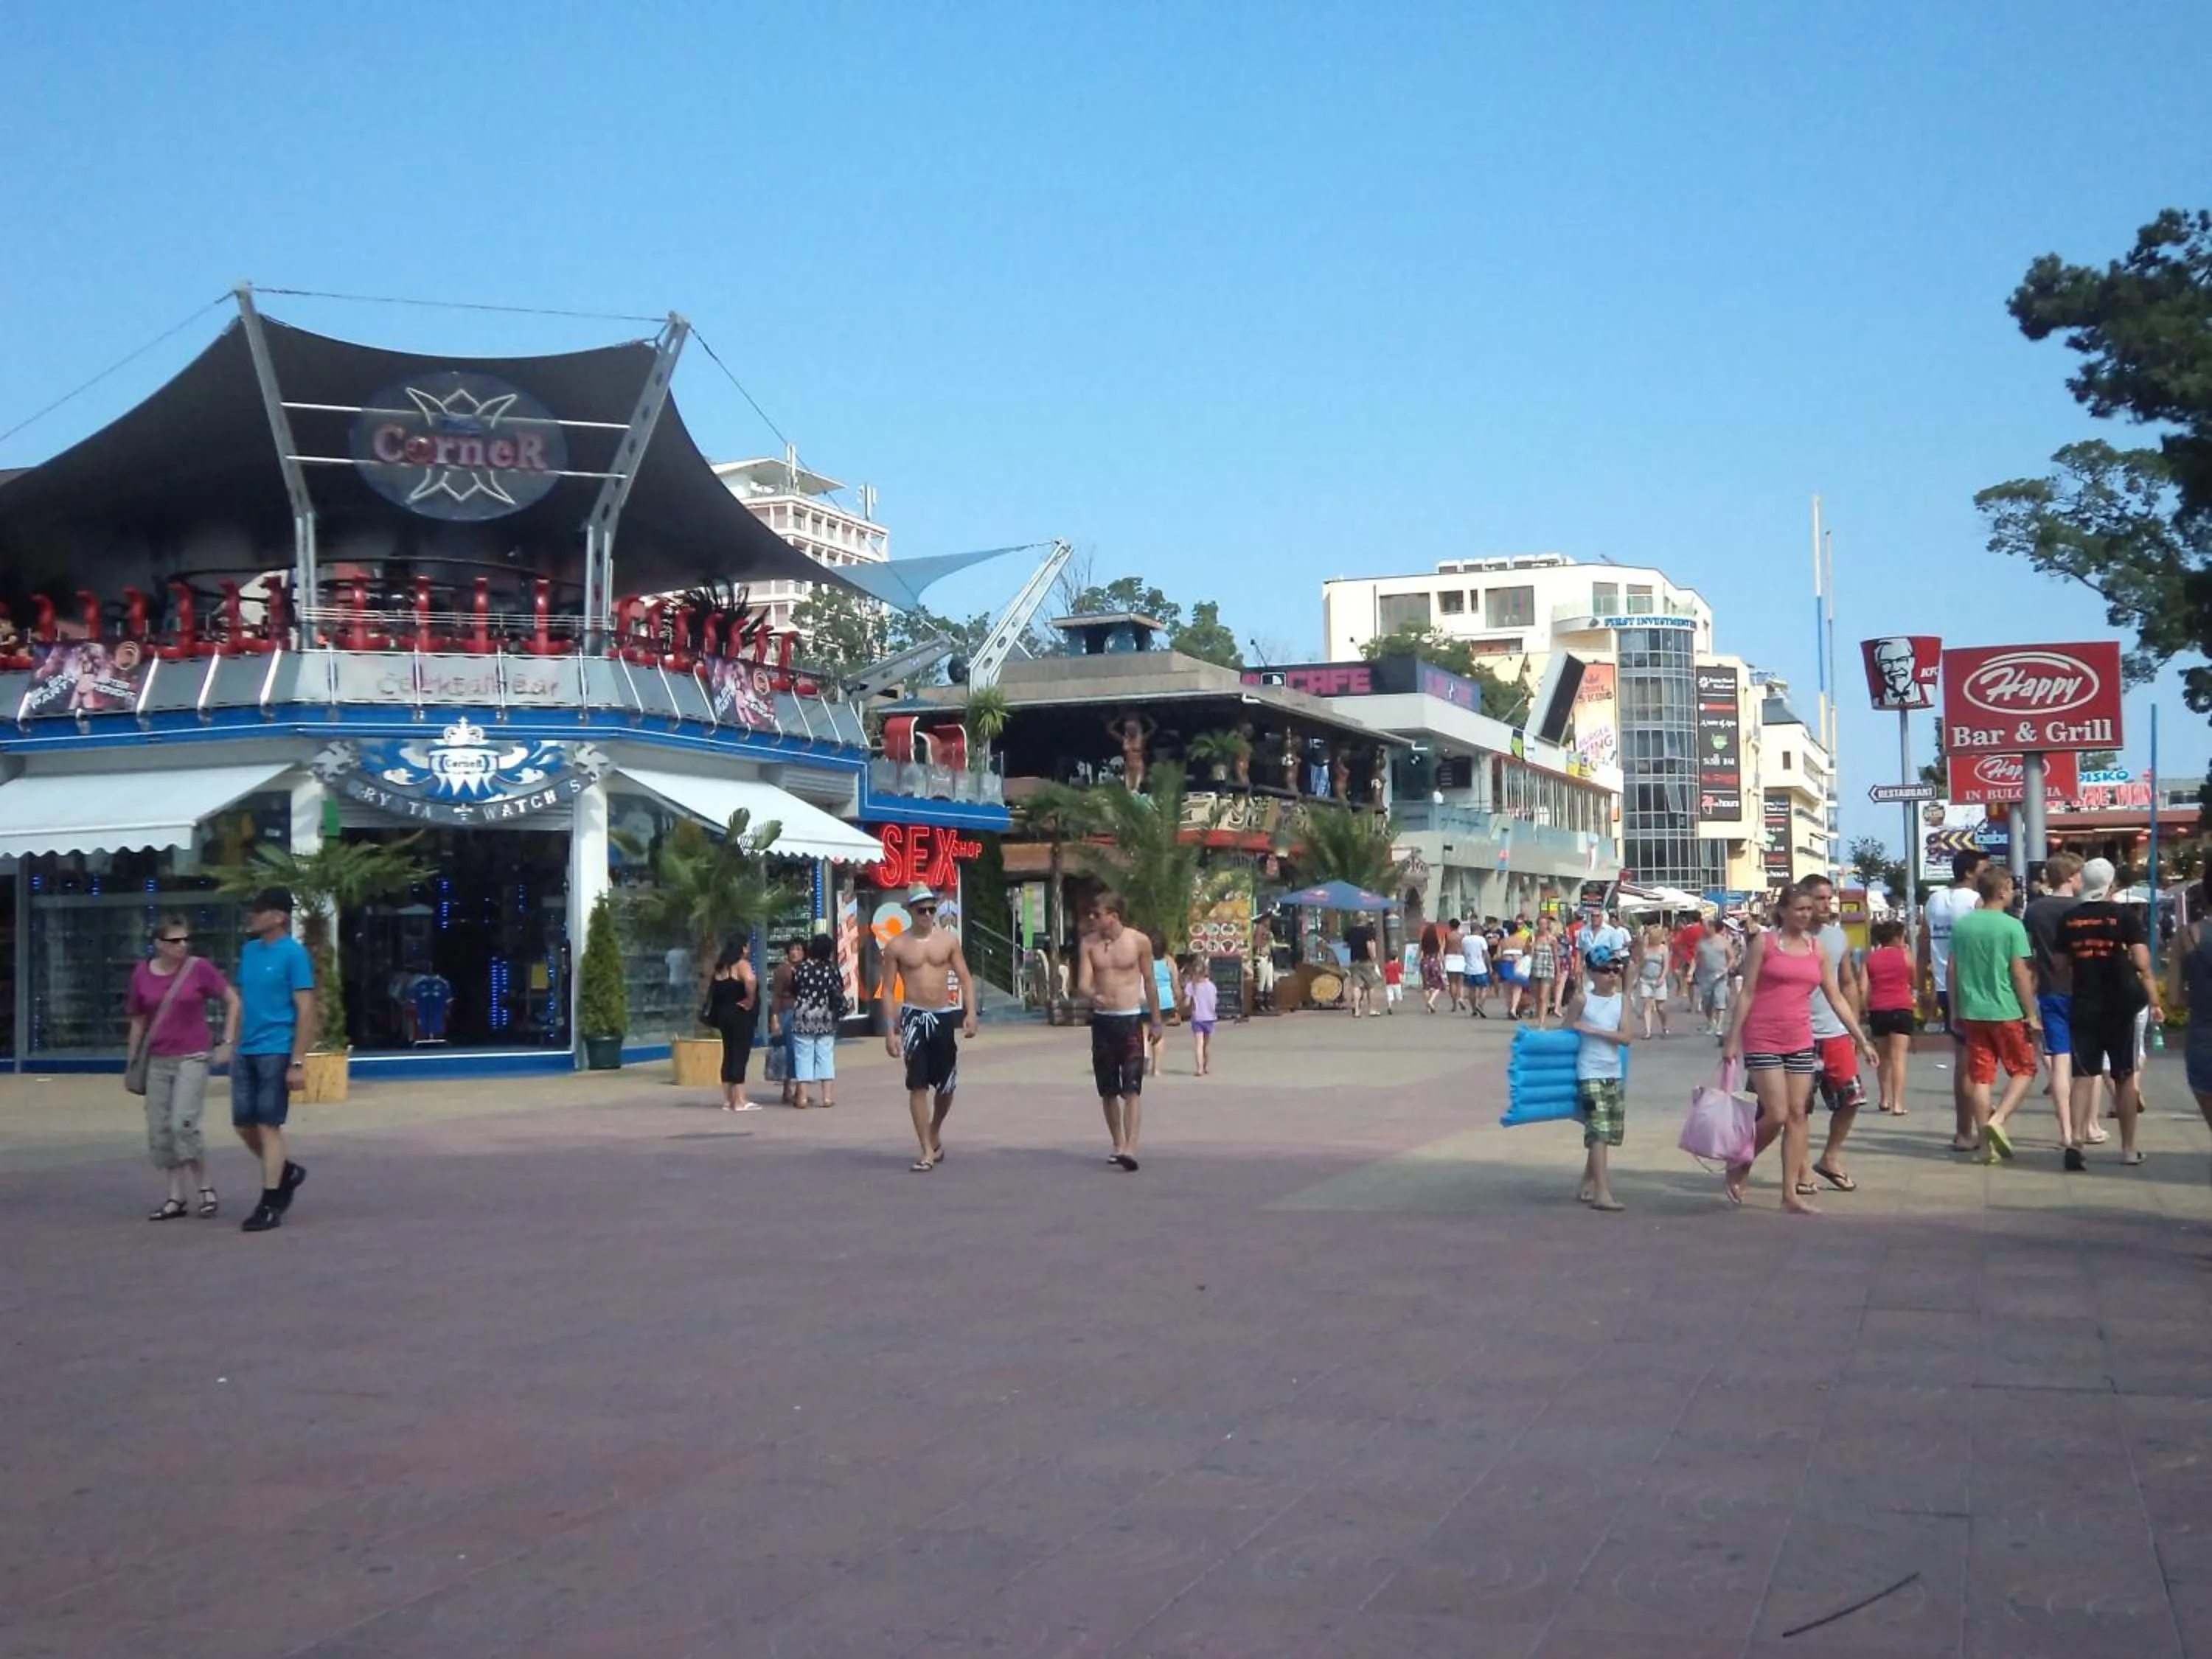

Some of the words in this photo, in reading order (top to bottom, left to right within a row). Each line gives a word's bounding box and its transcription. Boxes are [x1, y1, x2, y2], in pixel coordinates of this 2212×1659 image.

[373, 424, 548, 470] CorneR
[1287, 667, 1371, 695] CAFE
[1979, 666, 2084, 706] Happy
[1952, 726, 2006, 747] Bar
[2014, 720, 2037, 742] &
[2045, 719, 2113, 742] Grill
[1982, 759, 2024, 780] Hap
[1965, 790, 1980, 801] IN
[1987, 786, 2062, 800] BULIA
[879, 824, 958, 888] SEX
[952, 840, 982, 859] SHOP
